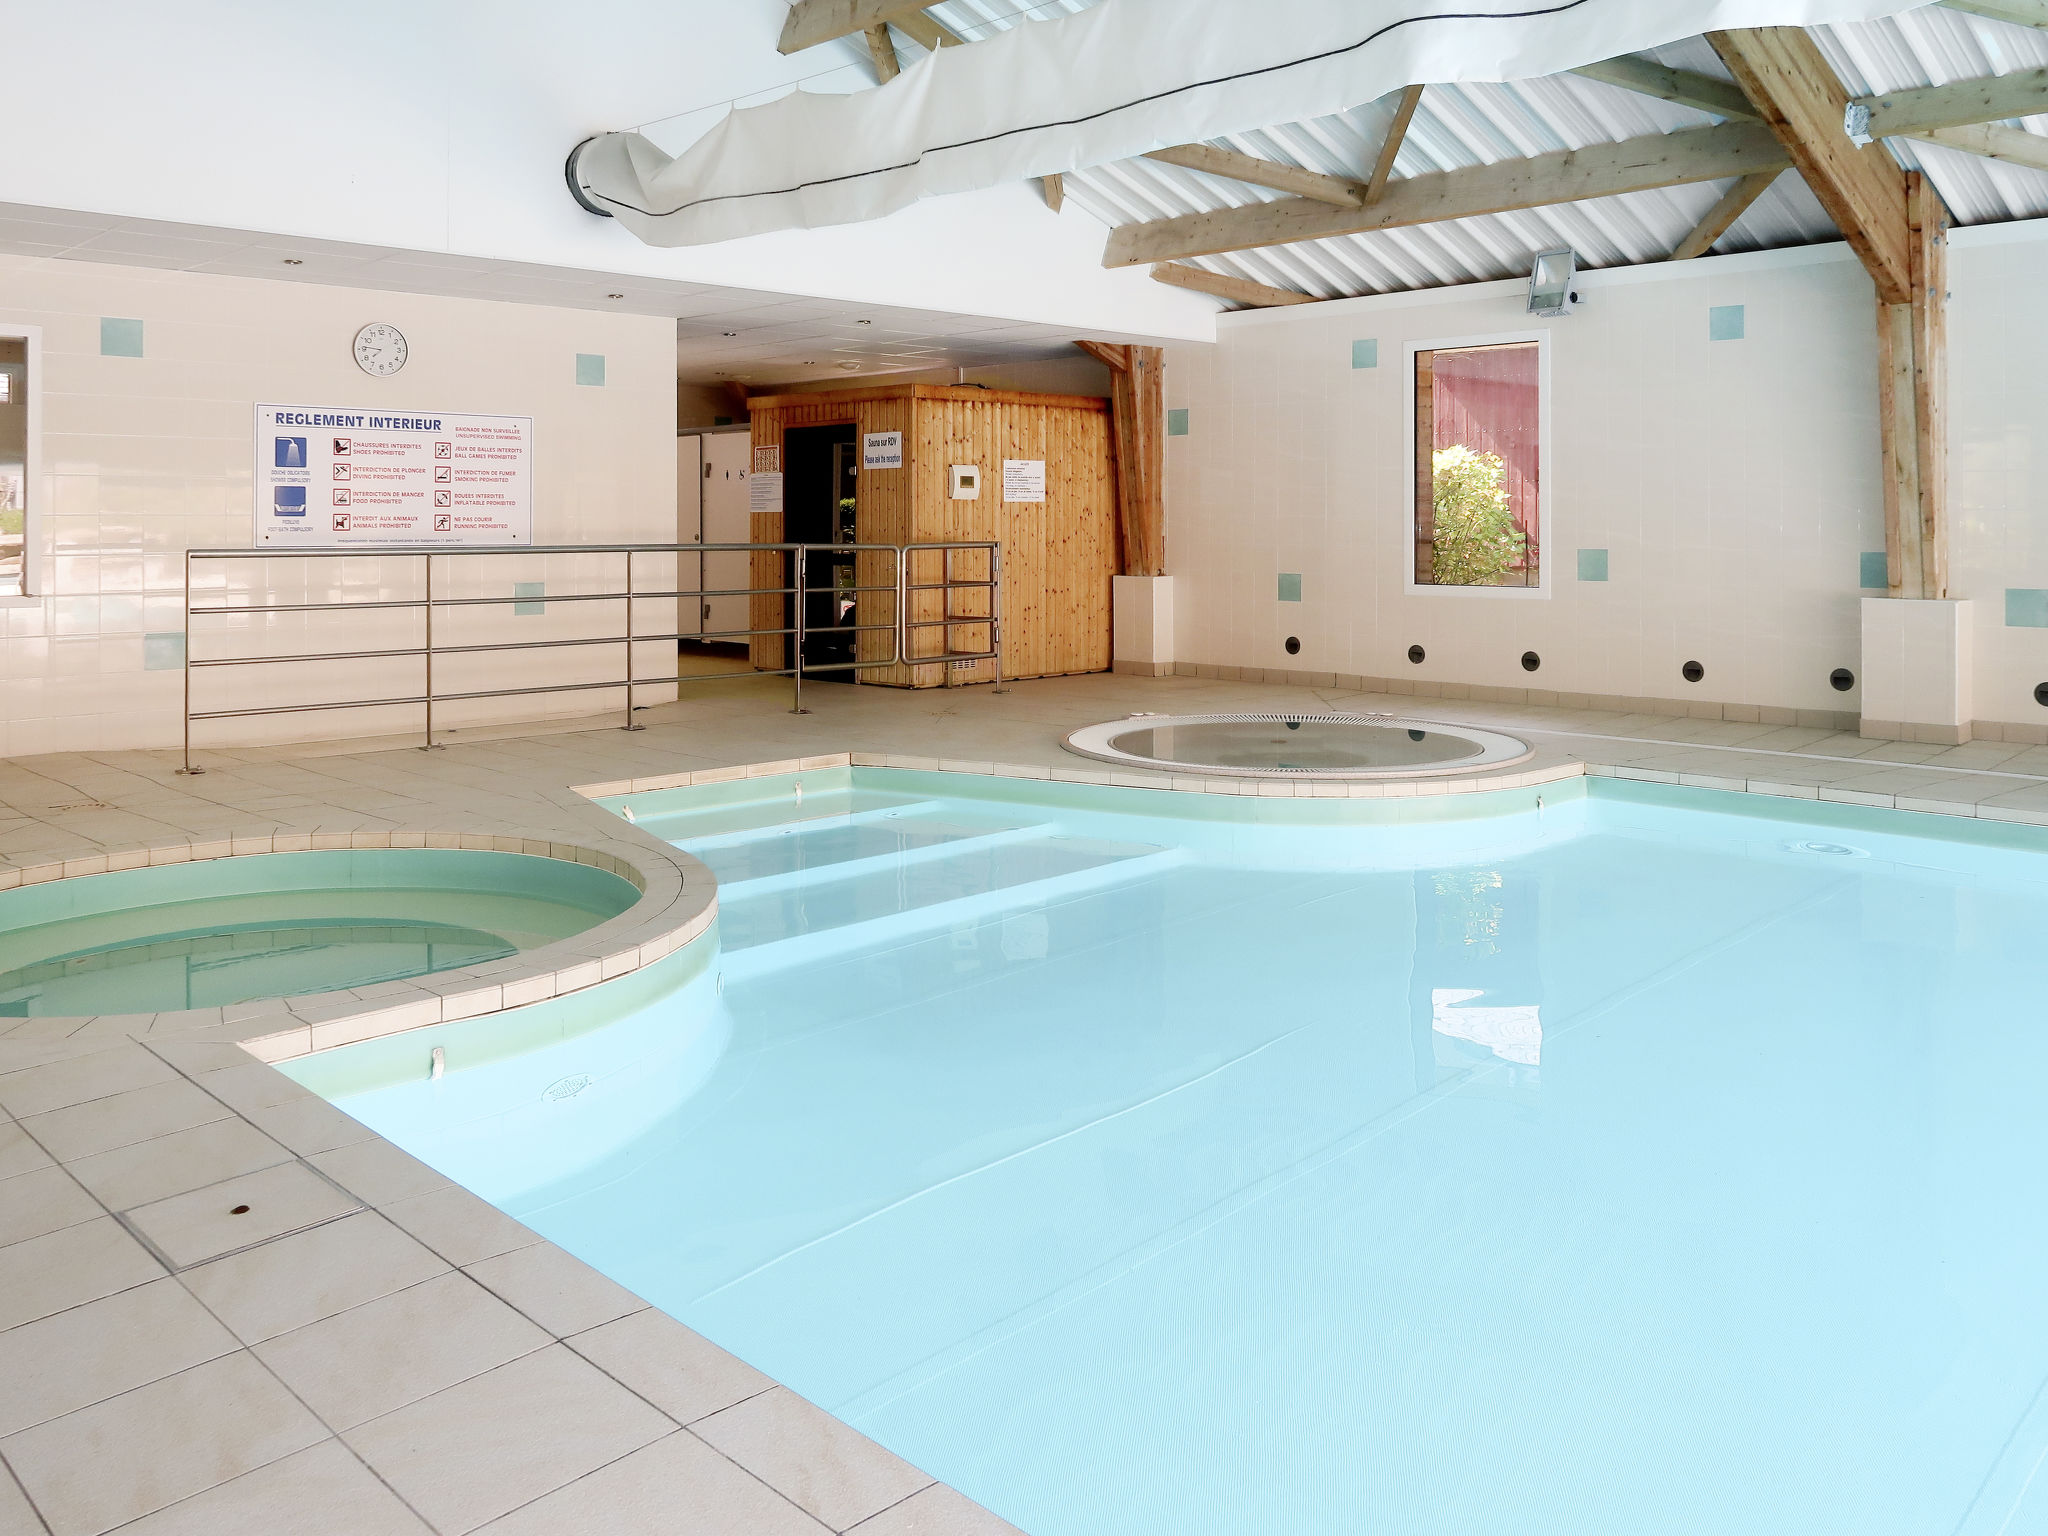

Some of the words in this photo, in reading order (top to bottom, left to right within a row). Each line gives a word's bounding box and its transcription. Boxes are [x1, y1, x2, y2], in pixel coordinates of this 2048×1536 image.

[275, 412, 364, 428] REGLEMENT
[369, 416, 442, 431] INTERIEUR
[868, 438, 880, 447] Sauna
[888, 436, 897, 446] RDV
[865, 455, 874, 464] Please
[886, 454, 900, 464] reception
